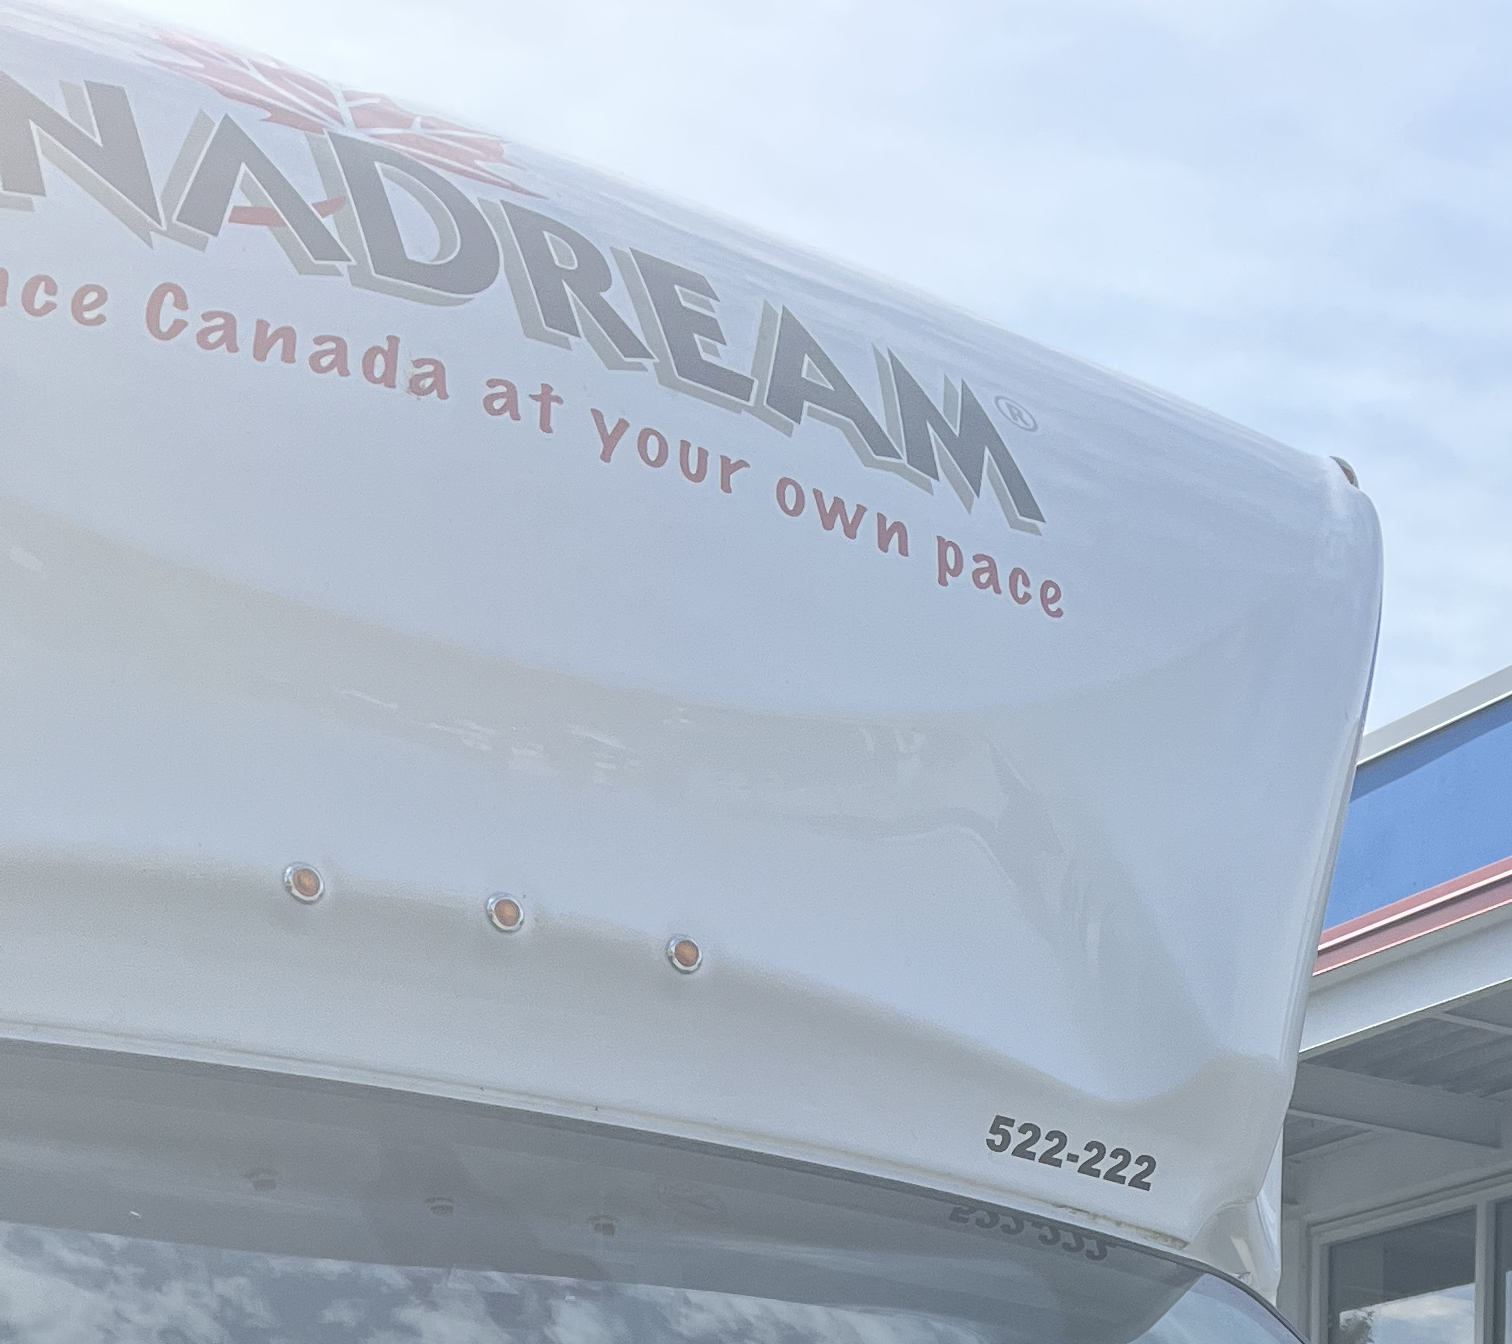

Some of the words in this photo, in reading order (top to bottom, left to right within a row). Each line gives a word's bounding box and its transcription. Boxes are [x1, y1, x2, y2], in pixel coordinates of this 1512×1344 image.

[0, 267, 108, 326] ce
[145, 282, 450, 402] Canada
[482, 377, 564, 434] at
[591, 408, 751, 494] your
[776, 476, 909, 557] own
[937, 535, 1063, 618] pace
[986, 1114, 1157, 1191] 522-222
